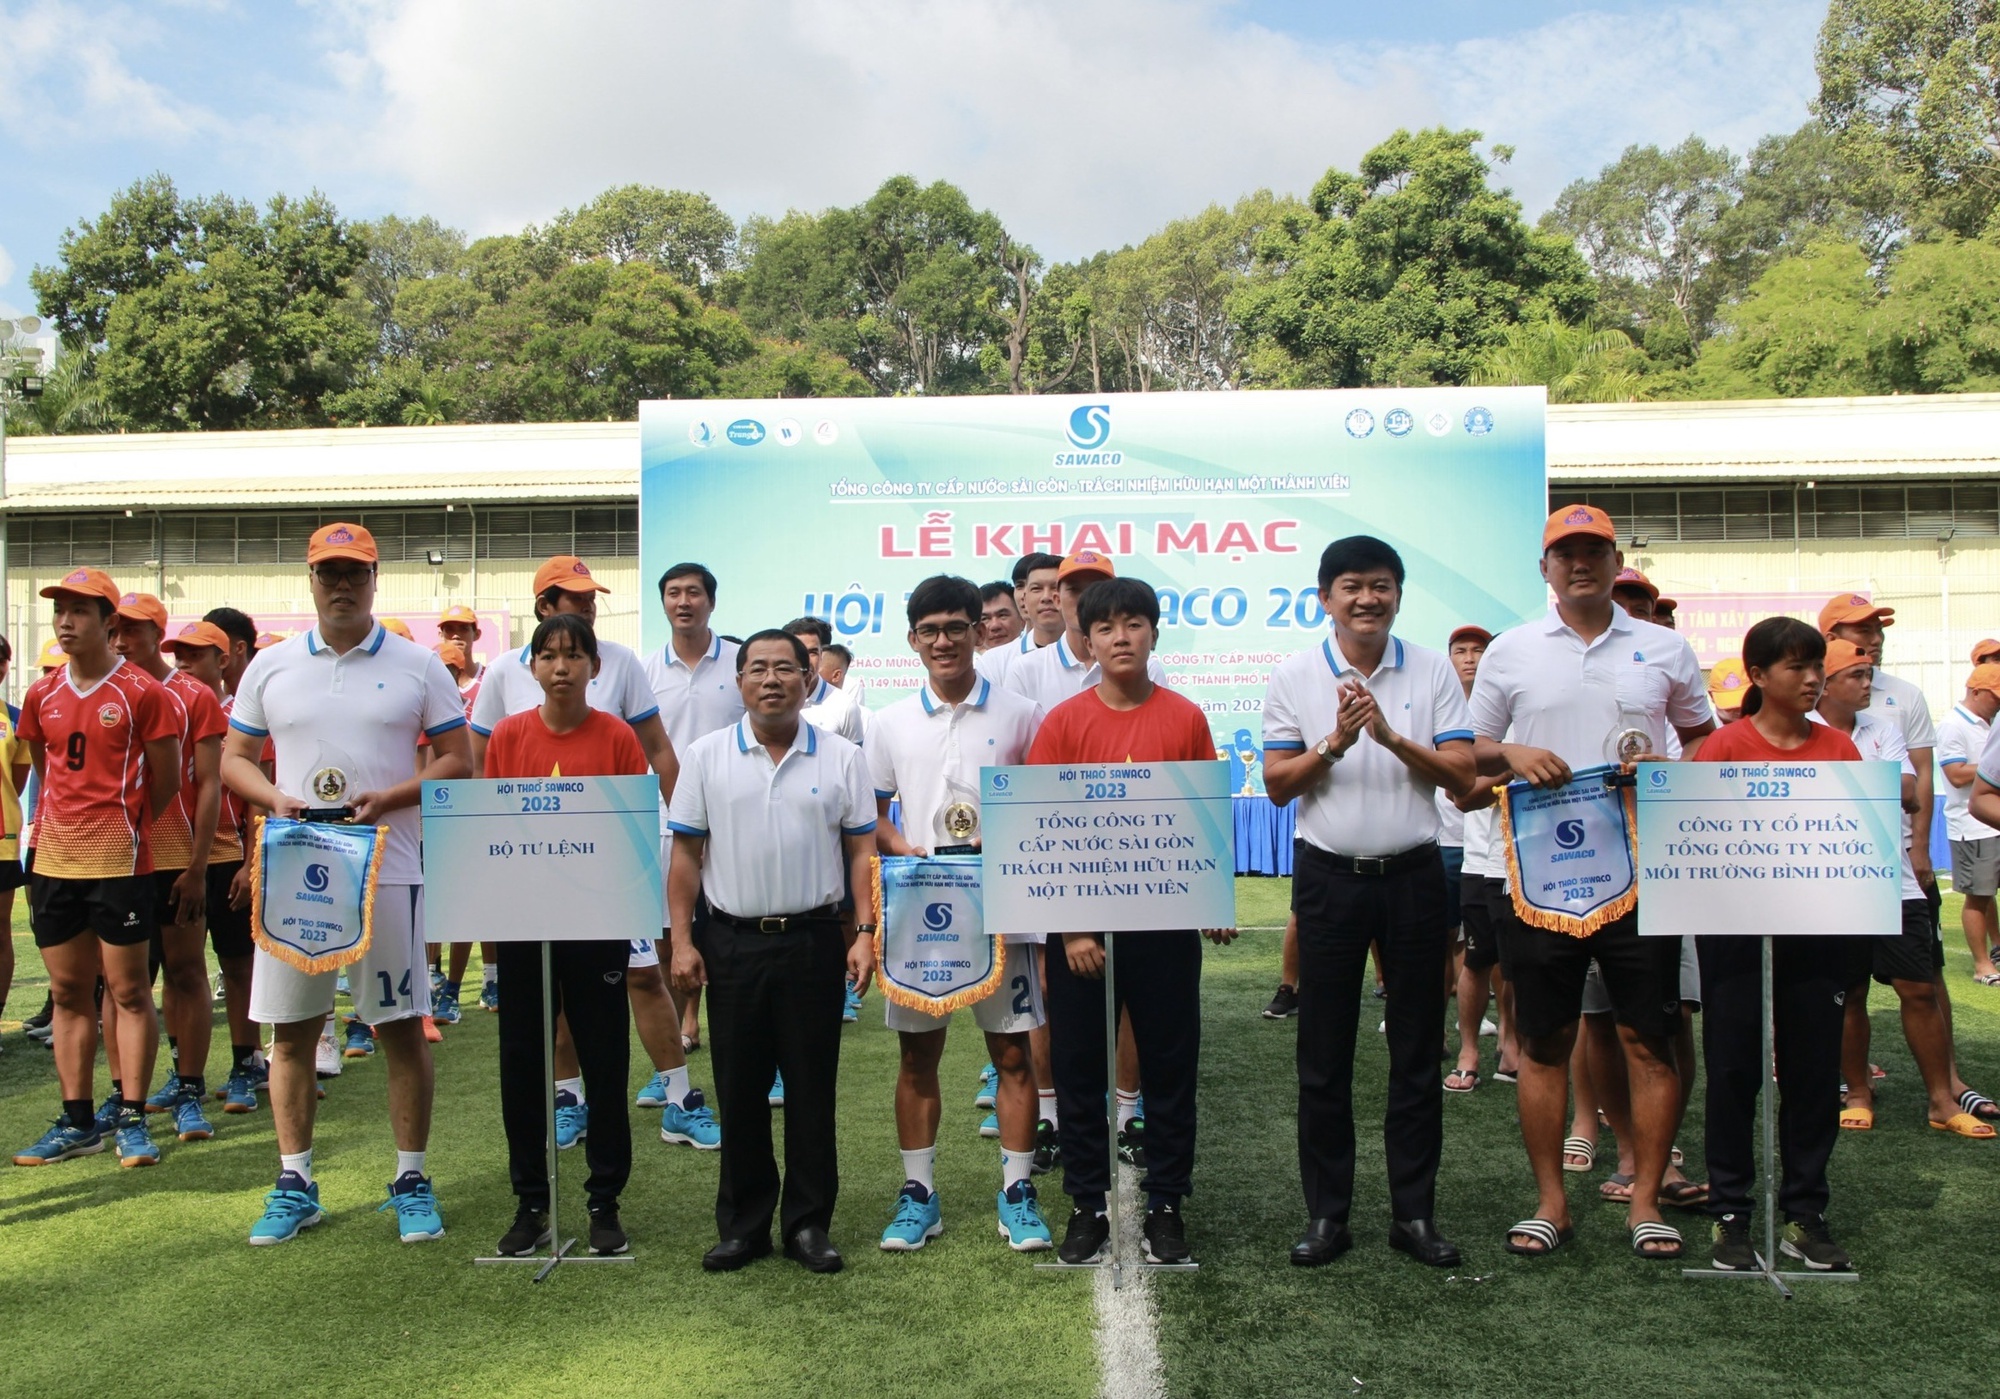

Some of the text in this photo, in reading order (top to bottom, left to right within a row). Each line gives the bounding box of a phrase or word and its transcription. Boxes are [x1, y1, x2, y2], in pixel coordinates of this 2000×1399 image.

[1055, 453, 1121, 466] SAWACO
[829, 477, 868, 496] TỔNG
[871, 480, 914, 495] CÔNG
[917, 482, 933, 495] TY
[935, 476, 964, 495] CẤP
[967, 479, 1008, 494] NƯỚC
[1011, 477, 1033, 494] SÀI
[1035, 477, 1068, 494] GÒN
[1079, 475, 1124, 493] TRÁCH
[1127, 475, 1169, 495] NHIỆM
[1173, 475, 1201, 492] HỮU
[1204, 477, 1233, 494] HẠN
[1237, 474, 1267, 494] MỘT
[1270, 473, 1316, 490] THÀNH
[1319, 472, 1349, 489] VIÊN
[881, 512, 1298, 562] LỄ KHAI MẠC
[804, 583, 885, 646] HỘI
[886, 654, 921, 668] MỪNG
[1163, 654, 1199, 665] CÔNG
[1203, 655, 1215, 664] TY
[1219, 650, 1244, 664] CẤP
[1247, 653, 1282, 664] NƯỚC
[870, 679, 889, 688] 149
[893, 676, 919, 687] NĂM
[1192, 674, 1230, 685] THÀNH
[1234, 670, 1258, 684] PHỐ
[1233, 700, 1262, 711] 202
[67, 731, 87, 772] 9
[1110, 769, 1151, 779] SAWACO
[1773, 768, 1816, 778] SAWACO
[545, 782, 584, 792] SAWACO
[1085, 783, 1126, 799] 2023
[1746, 781, 1790, 798] 2023
[522, 796, 561, 812] 2023
[1036, 811, 1176, 829] TỔNG CÔNG TY
[1678, 813, 1859, 833] CÔNG TY CỔ PHẦN
[489, 839, 594, 858] BỘ TƯ LỆNH
[1019, 834, 1195, 852] CẤP NƯỚC SÀI GÒN
[1665, 837, 1873, 856] TỔNG CÔNG TY NƯỚC
[1551, 849, 1596, 863] SAWACO
[999, 856, 1216, 876] TRÁCH NHIỆM HỮU HẠN
[1644, 862, 1894, 880] MÔI TRƯỜNG BÌNH DƯƠNG
[1580, 874, 1611, 885] SAWACO
[1027, 879, 1189, 900] MỘT THÀNH VIÊN
[1563, 886, 1594, 901] 2023
[296, 892, 334, 905] SAWACO
[316, 921, 343, 932] SAWACO
[300, 929, 327, 942] 2023
[916, 934, 959, 942] SAWACO
[941, 960, 971, 968] SAWACO
[922, 971, 952, 982] 2023
